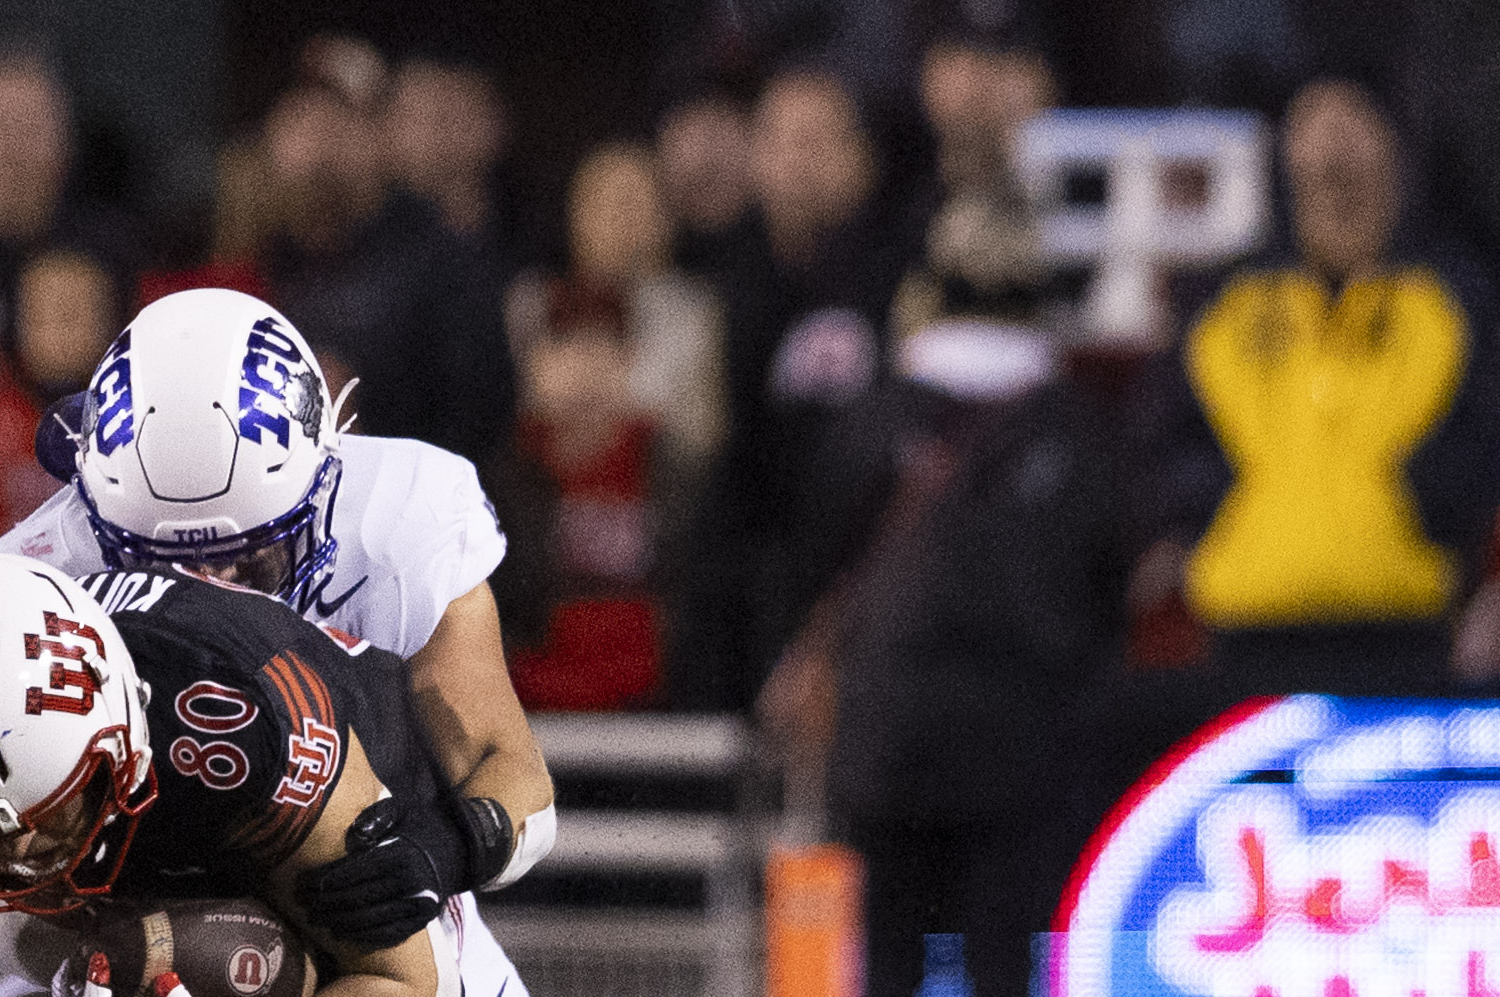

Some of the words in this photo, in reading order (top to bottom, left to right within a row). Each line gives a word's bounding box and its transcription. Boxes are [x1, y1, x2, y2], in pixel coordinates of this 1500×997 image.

[238, 316, 303, 451] TCU
[169, 680, 261, 791] 80
[203, 912, 247, 924] ISSUE
[233, 950, 262, 986] U
